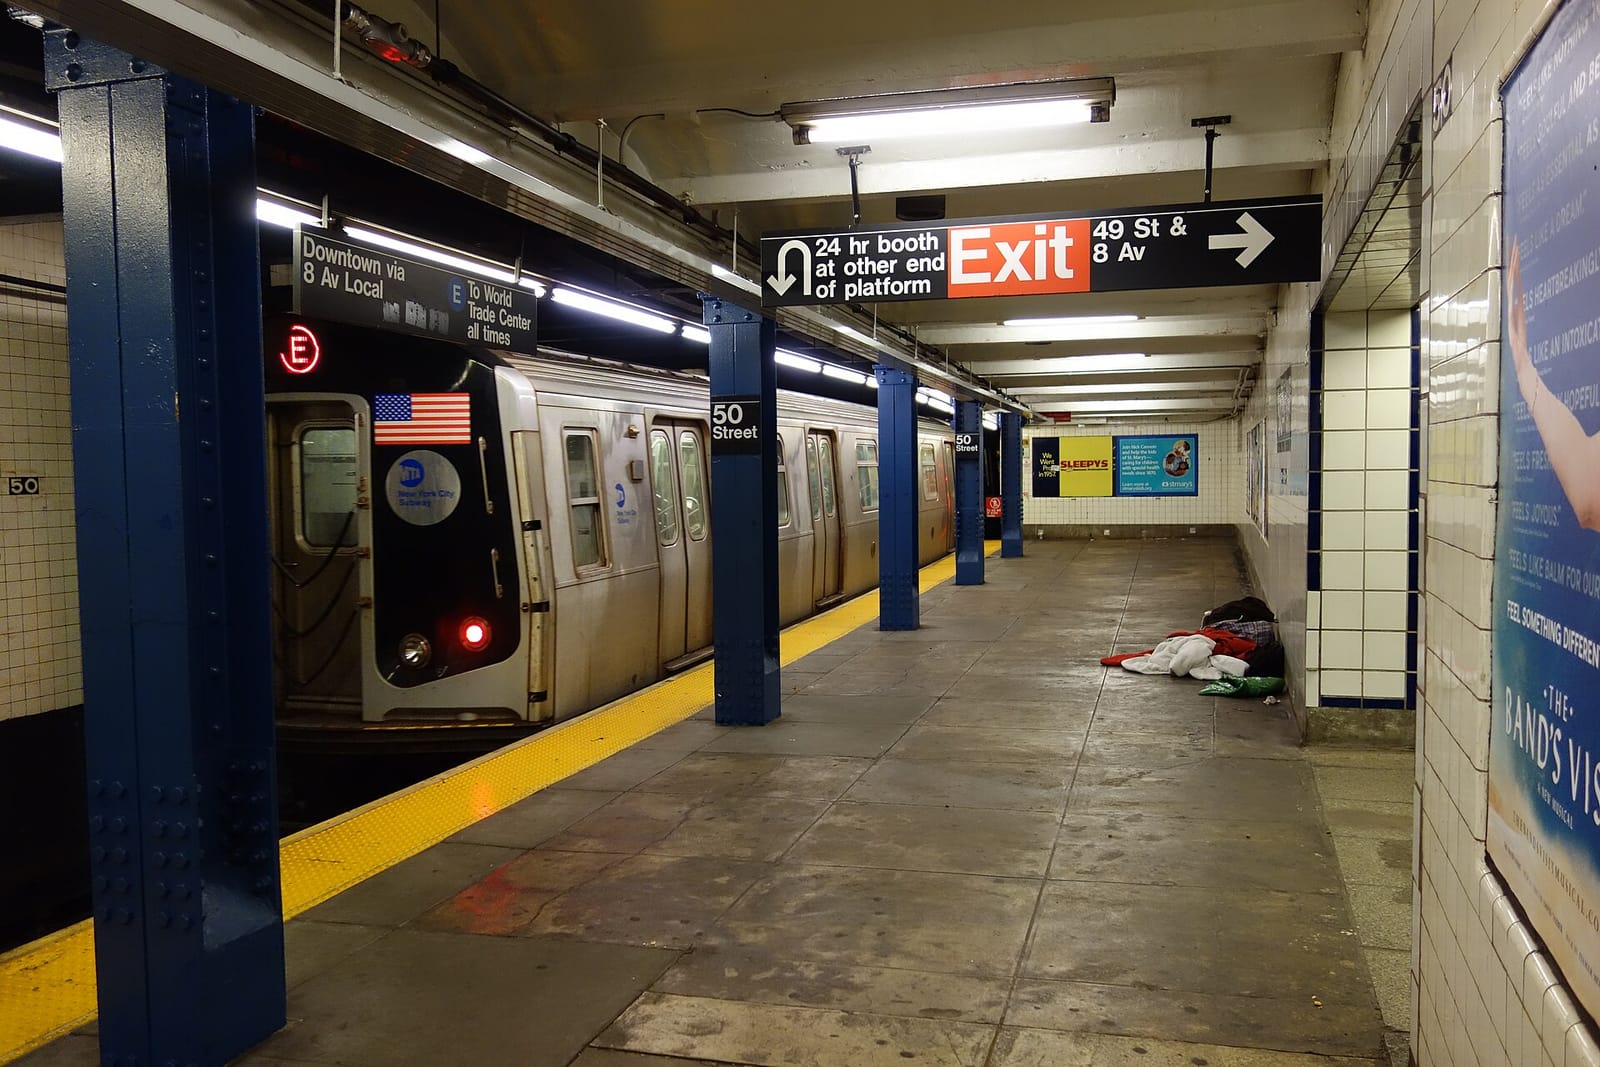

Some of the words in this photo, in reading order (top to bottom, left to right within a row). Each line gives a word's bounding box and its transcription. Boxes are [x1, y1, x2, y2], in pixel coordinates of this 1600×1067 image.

[1433, 63, 1450, 132] 50
[1568, 70, 1586, 108] AND
[1586, 117, 1598, 147] AS
[1092, 219, 1124, 240] 49
[1134, 217, 1159, 239] St
[1169, 216, 1187, 236] &
[815, 238, 841, 257] 24
[849, 236, 870, 255] hr
[878, 234, 939, 253] booth
[951, 224, 1074, 285] Exit
[1092, 243, 1108, 263] 8
[1117, 242, 1146, 262] Av
[303, 235, 382, 276] Downtown
[386, 261, 405, 282] via
[815, 260, 835, 277] at
[844, 257, 898, 275] other
[906, 253, 945, 273] end
[303, 262, 314, 284] 8
[320, 266, 338, 289] Av
[345, 271, 384, 299] Local
[815, 281, 837, 299] of
[844, 276, 931, 301] platform
[453, 285, 462, 304] E
[467, 280, 480, 299] To
[484, 284, 512, 308] World
[467, 301, 496, 323] Trade
[499, 308, 532, 331] Center
[467, 323, 479, 340] all
[483, 326, 511, 346] times
[290, 336, 309, 364] E
[1533, 340, 1548, 364] LIKE
[1549, 336, 1560, 360] AN
[712, 404, 743, 425] 50
[712, 425, 758, 440] Street
[956, 434, 971, 445] 50
[955, 444, 978, 452] Street
[1060, 460, 1109, 469] SLEEPYS
[11, 478, 38, 494] 50
[439, 489, 454, 499] City
[1528, 553, 1543, 577] LIKE
[1544, 559, 1564, 585] BALM
[1566, 566, 1580, 593] FOR
[1582, 571, 1600, 599] OUR
[1507, 600, 1521, 625] FEEL
[1522, 607, 1562, 646] SOMETHING
[1505, 686, 1562, 785] BAND'S
